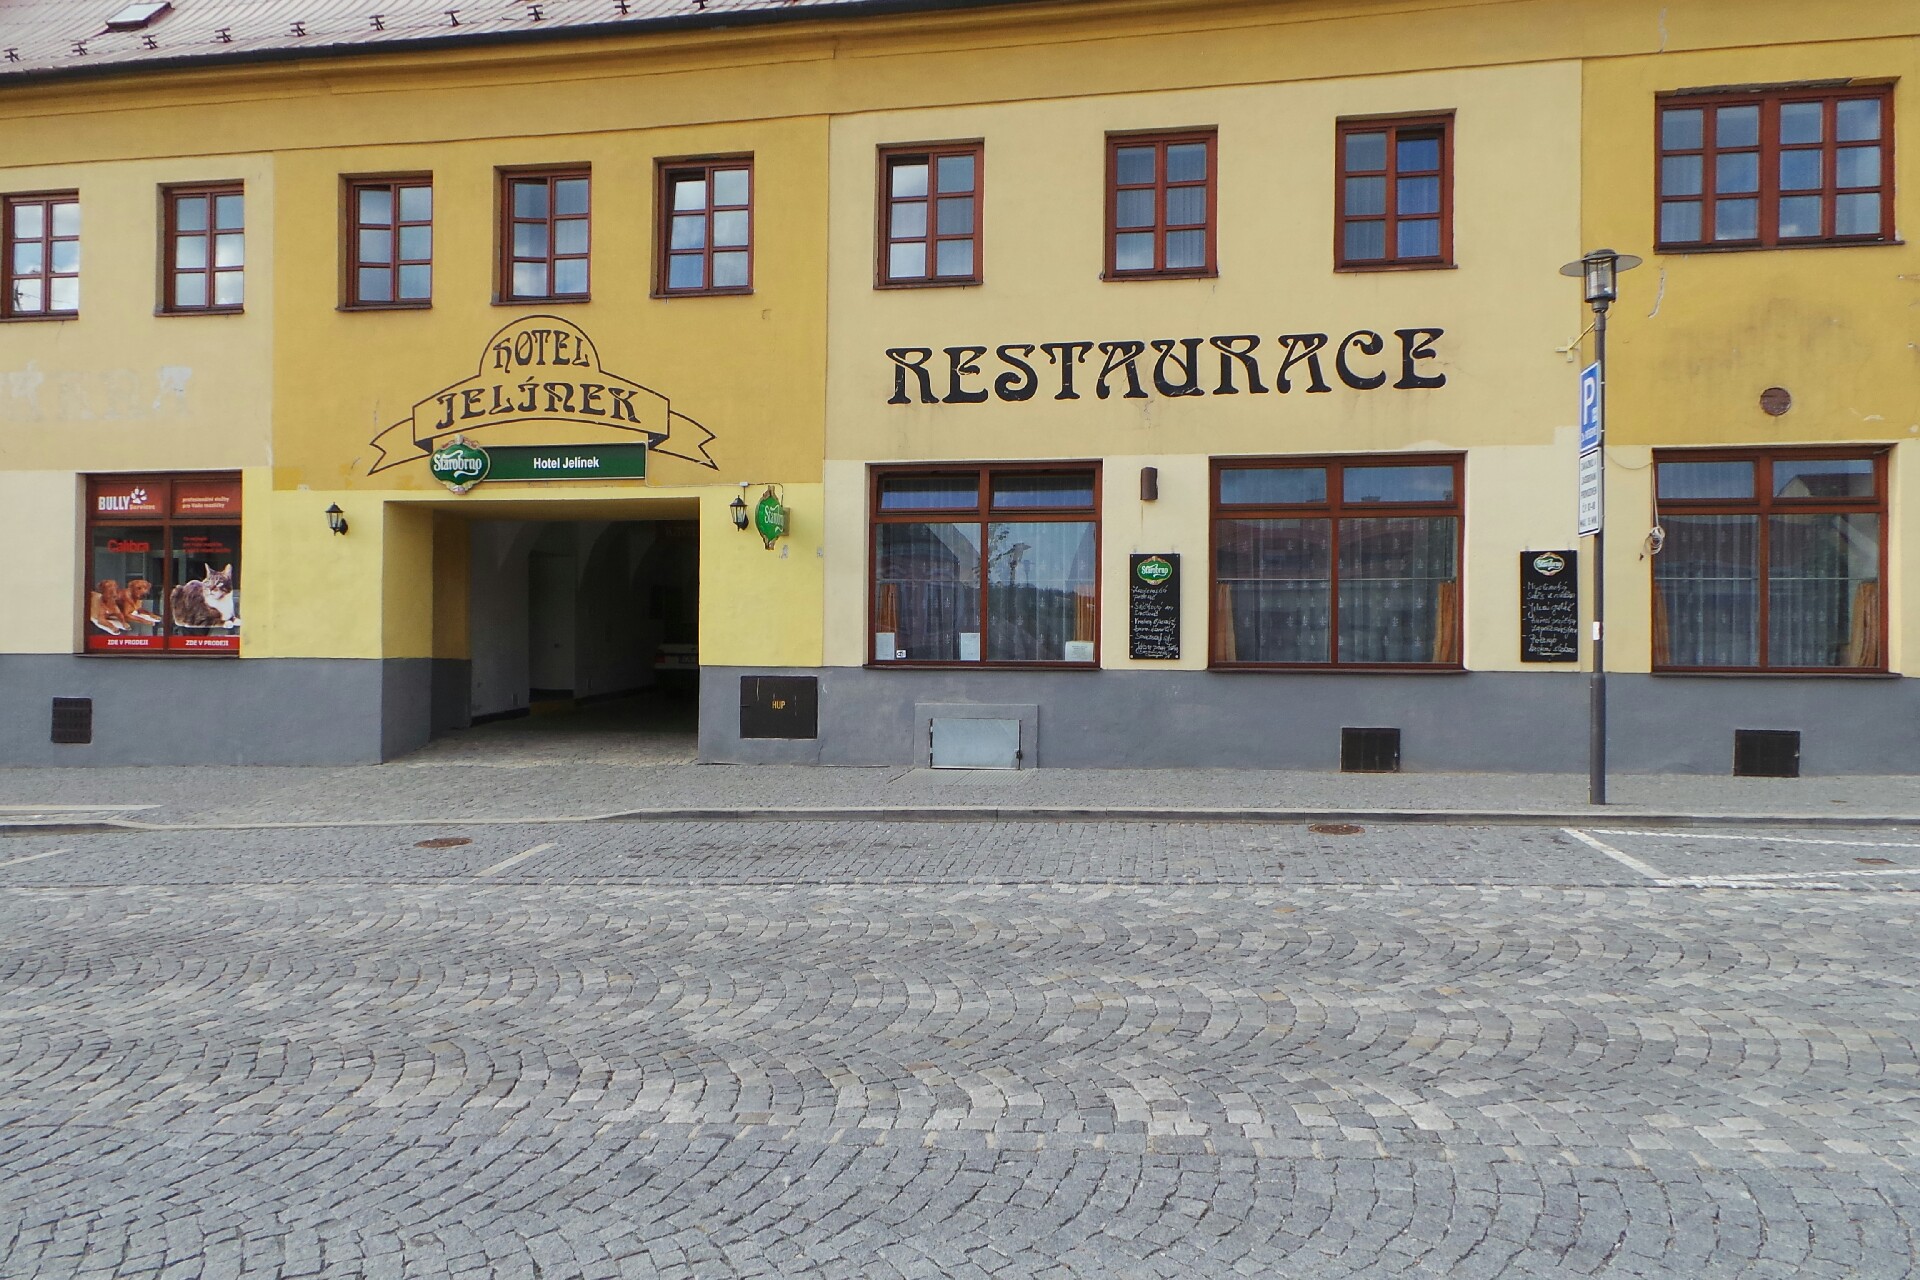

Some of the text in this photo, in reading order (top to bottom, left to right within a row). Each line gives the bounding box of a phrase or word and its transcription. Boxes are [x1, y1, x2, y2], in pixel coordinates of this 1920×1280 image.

[493, 330, 590, 373] HOTEL
[885, 327, 1446, 405] RESTAURACE
[436, 376, 641, 430] JELÍNEK
[1583, 377, 1595, 425] P
[433, 450, 482, 478] Starobrno
[533, 456, 600, 469] Hotel Jelínek
[98, 496, 130, 510] BULLY
[772, 700, 786, 709] HUP
